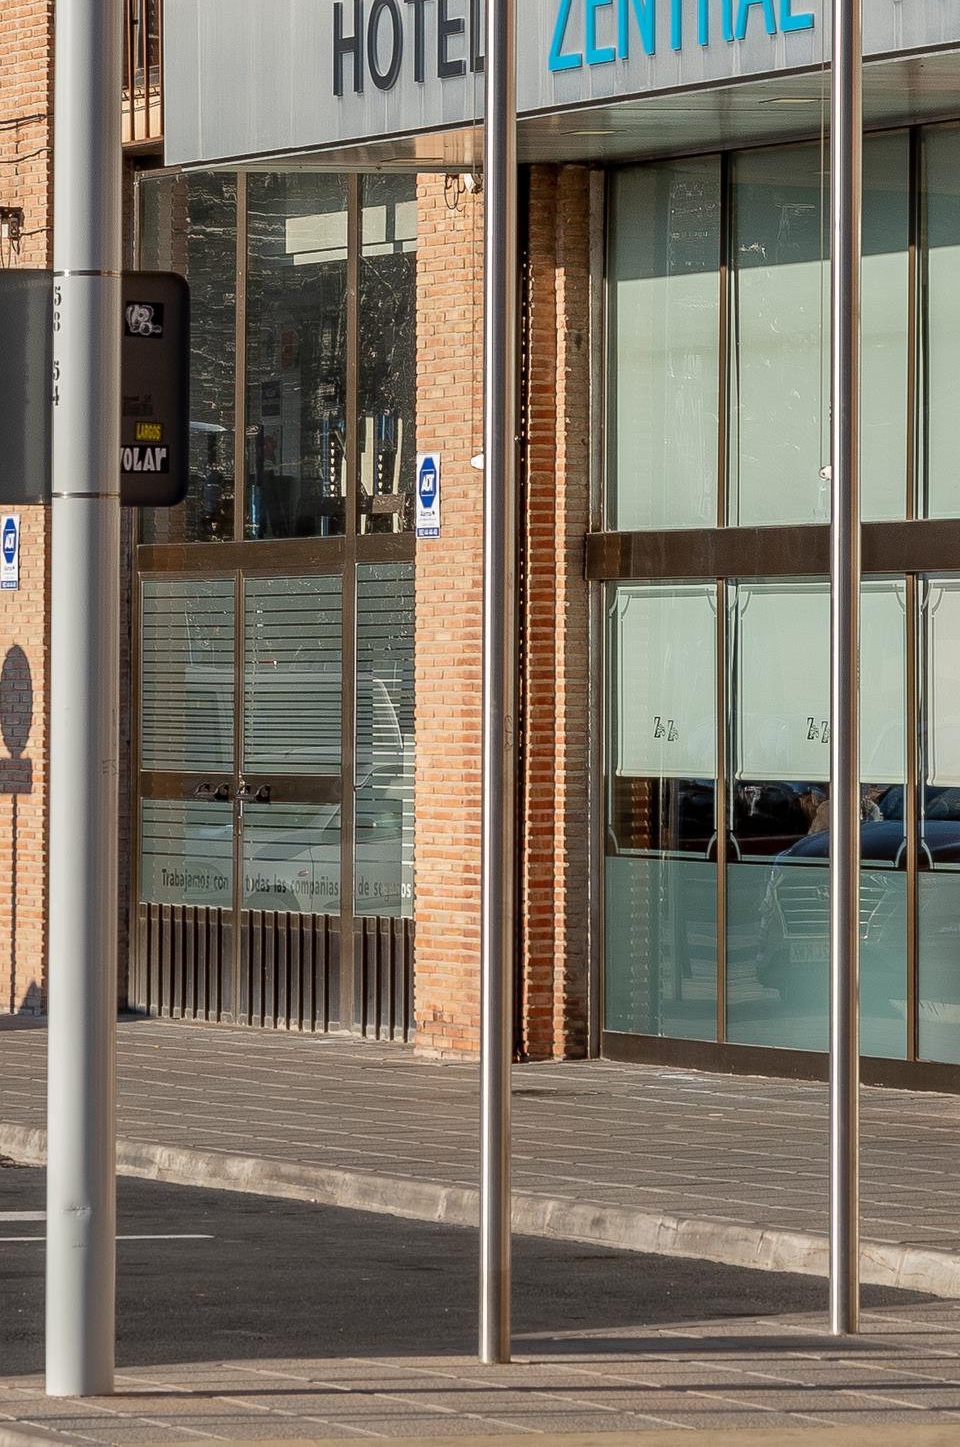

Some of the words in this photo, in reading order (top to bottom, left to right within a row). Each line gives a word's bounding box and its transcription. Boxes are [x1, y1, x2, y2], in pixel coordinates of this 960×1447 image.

[161, 868, 209, 892] Trabajamos
[214, 874, 229, 890] con
[246, 873, 270, 893] todas
[274, 874, 287, 893] las
[358, 875, 370, 896] de
